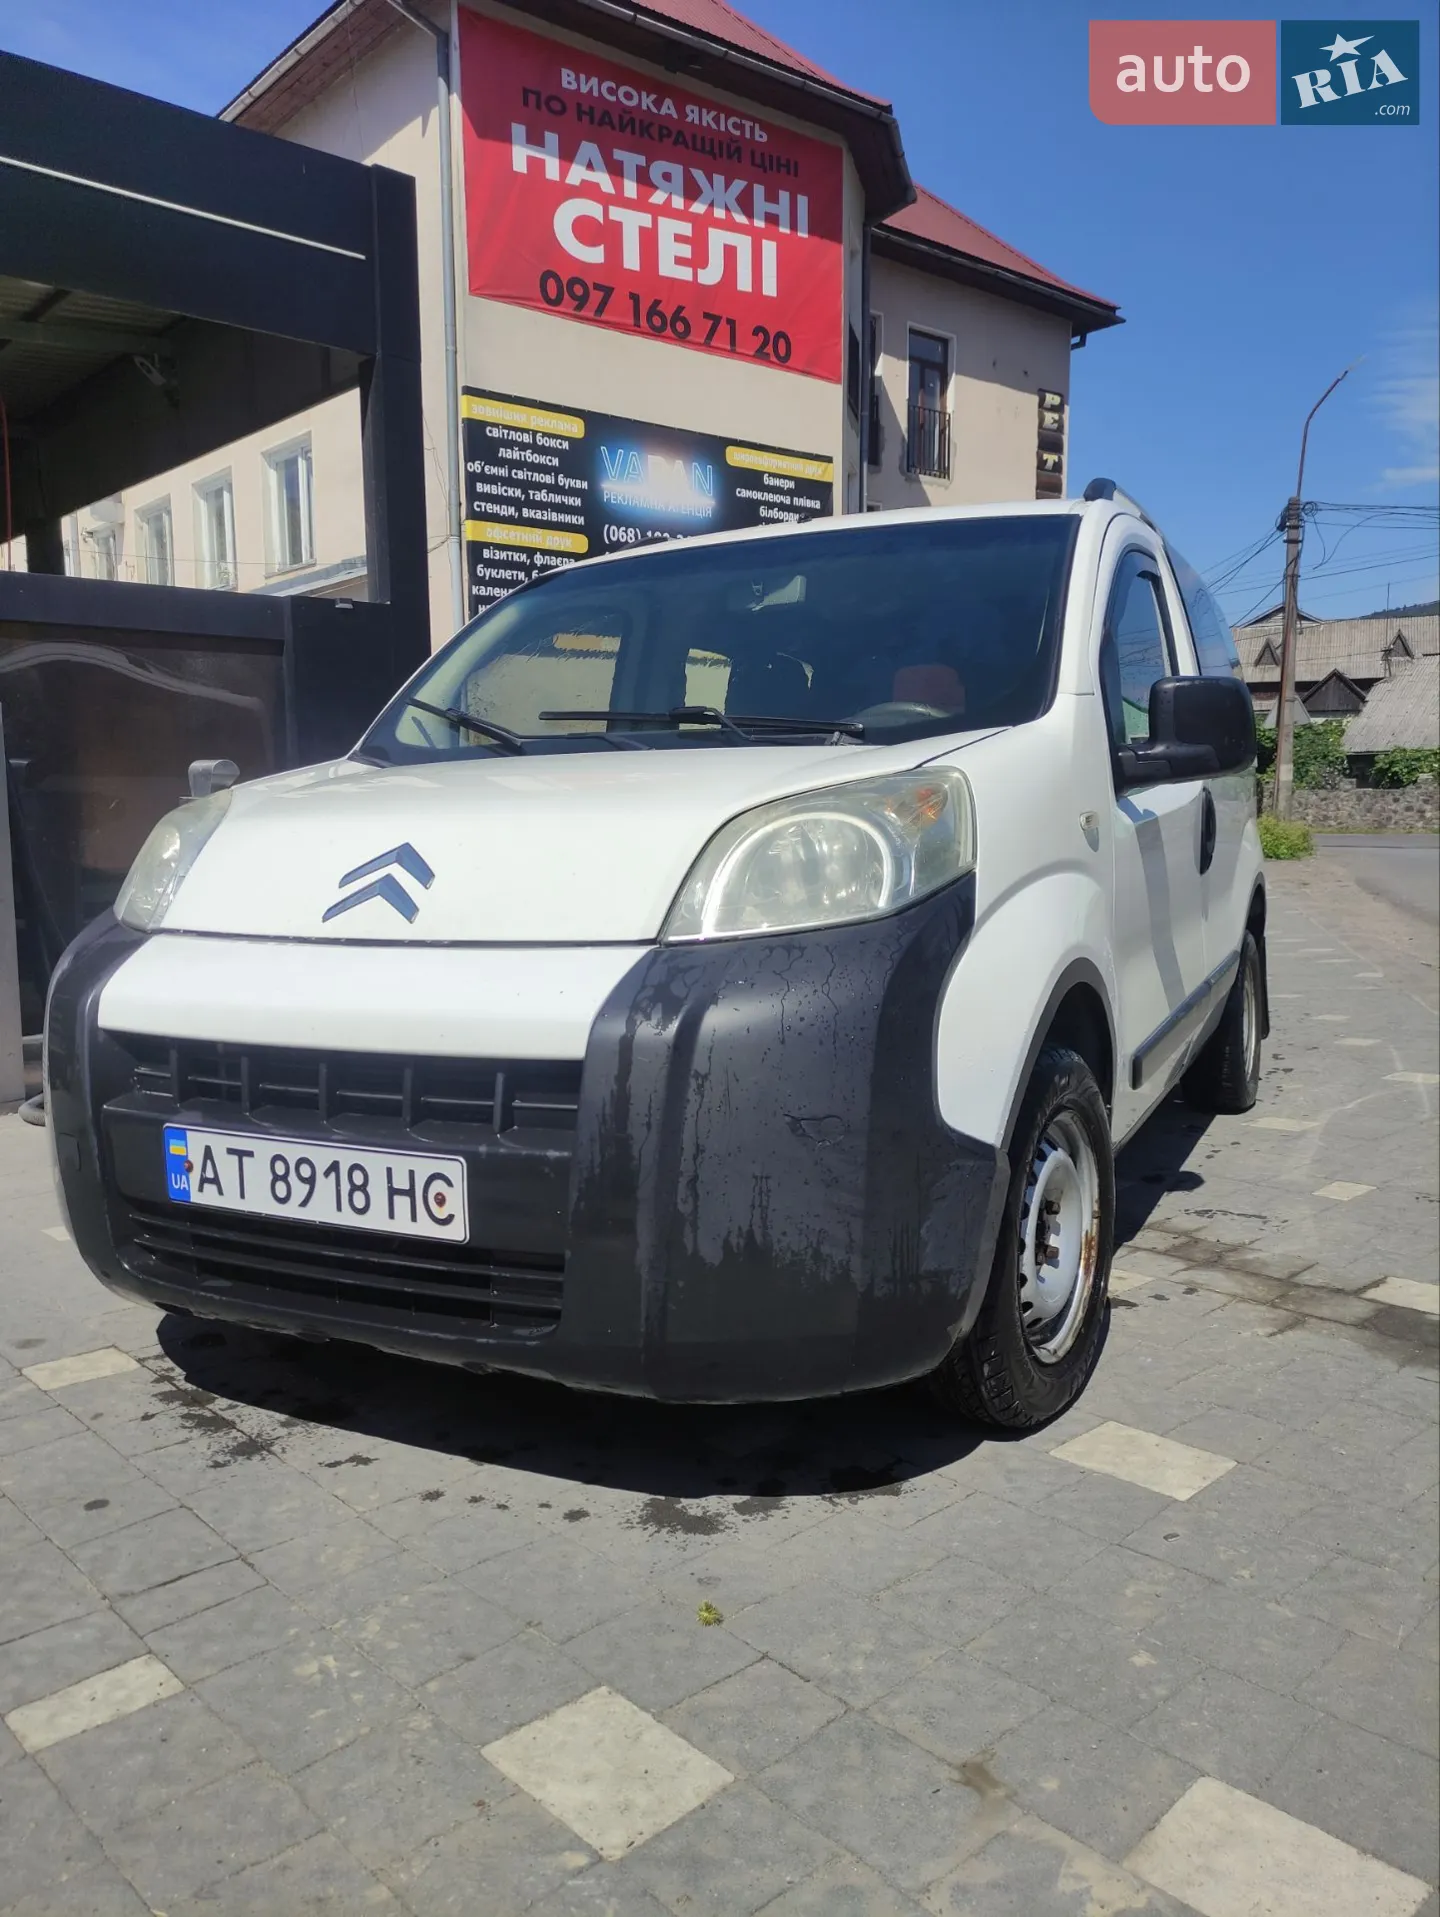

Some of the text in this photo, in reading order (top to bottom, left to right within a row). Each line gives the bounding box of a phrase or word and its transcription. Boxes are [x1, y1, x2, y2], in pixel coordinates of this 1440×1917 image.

[560, 67, 768, 143] ВИСОКА ЯКІСТЬ
[521, 86, 799, 178] ПО НАЙКРАЩІЙ ЦІНІ
[510, 122, 809, 239] НАТЯЖНІ
[552, 198, 778, 298] СТЕЛІ
[539, 270, 792, 364] 097 166 71 20
[486, 425, 569, 450] світлові бокси
[498, 446, 559, 467] лайтбокси
[511, 467, 555, 485] світлові
[558, 475, 588, 490] букви
[763, 473, 795, 490] банери
[476, 482, 581, 507] вивіски, таблички
[736, 487, 821, 509] самоклеюча плівка
[473, 500, 585, 526] стенди, вказівники
[603, 524, 641, 544] (068)
[483, 546, 530, 565] візитки,
[476, 564, 528, 583] буклети,
[171, 1173, 189, 1191] UA
[197, 1144, 455, 1226] AT 8918 HC
